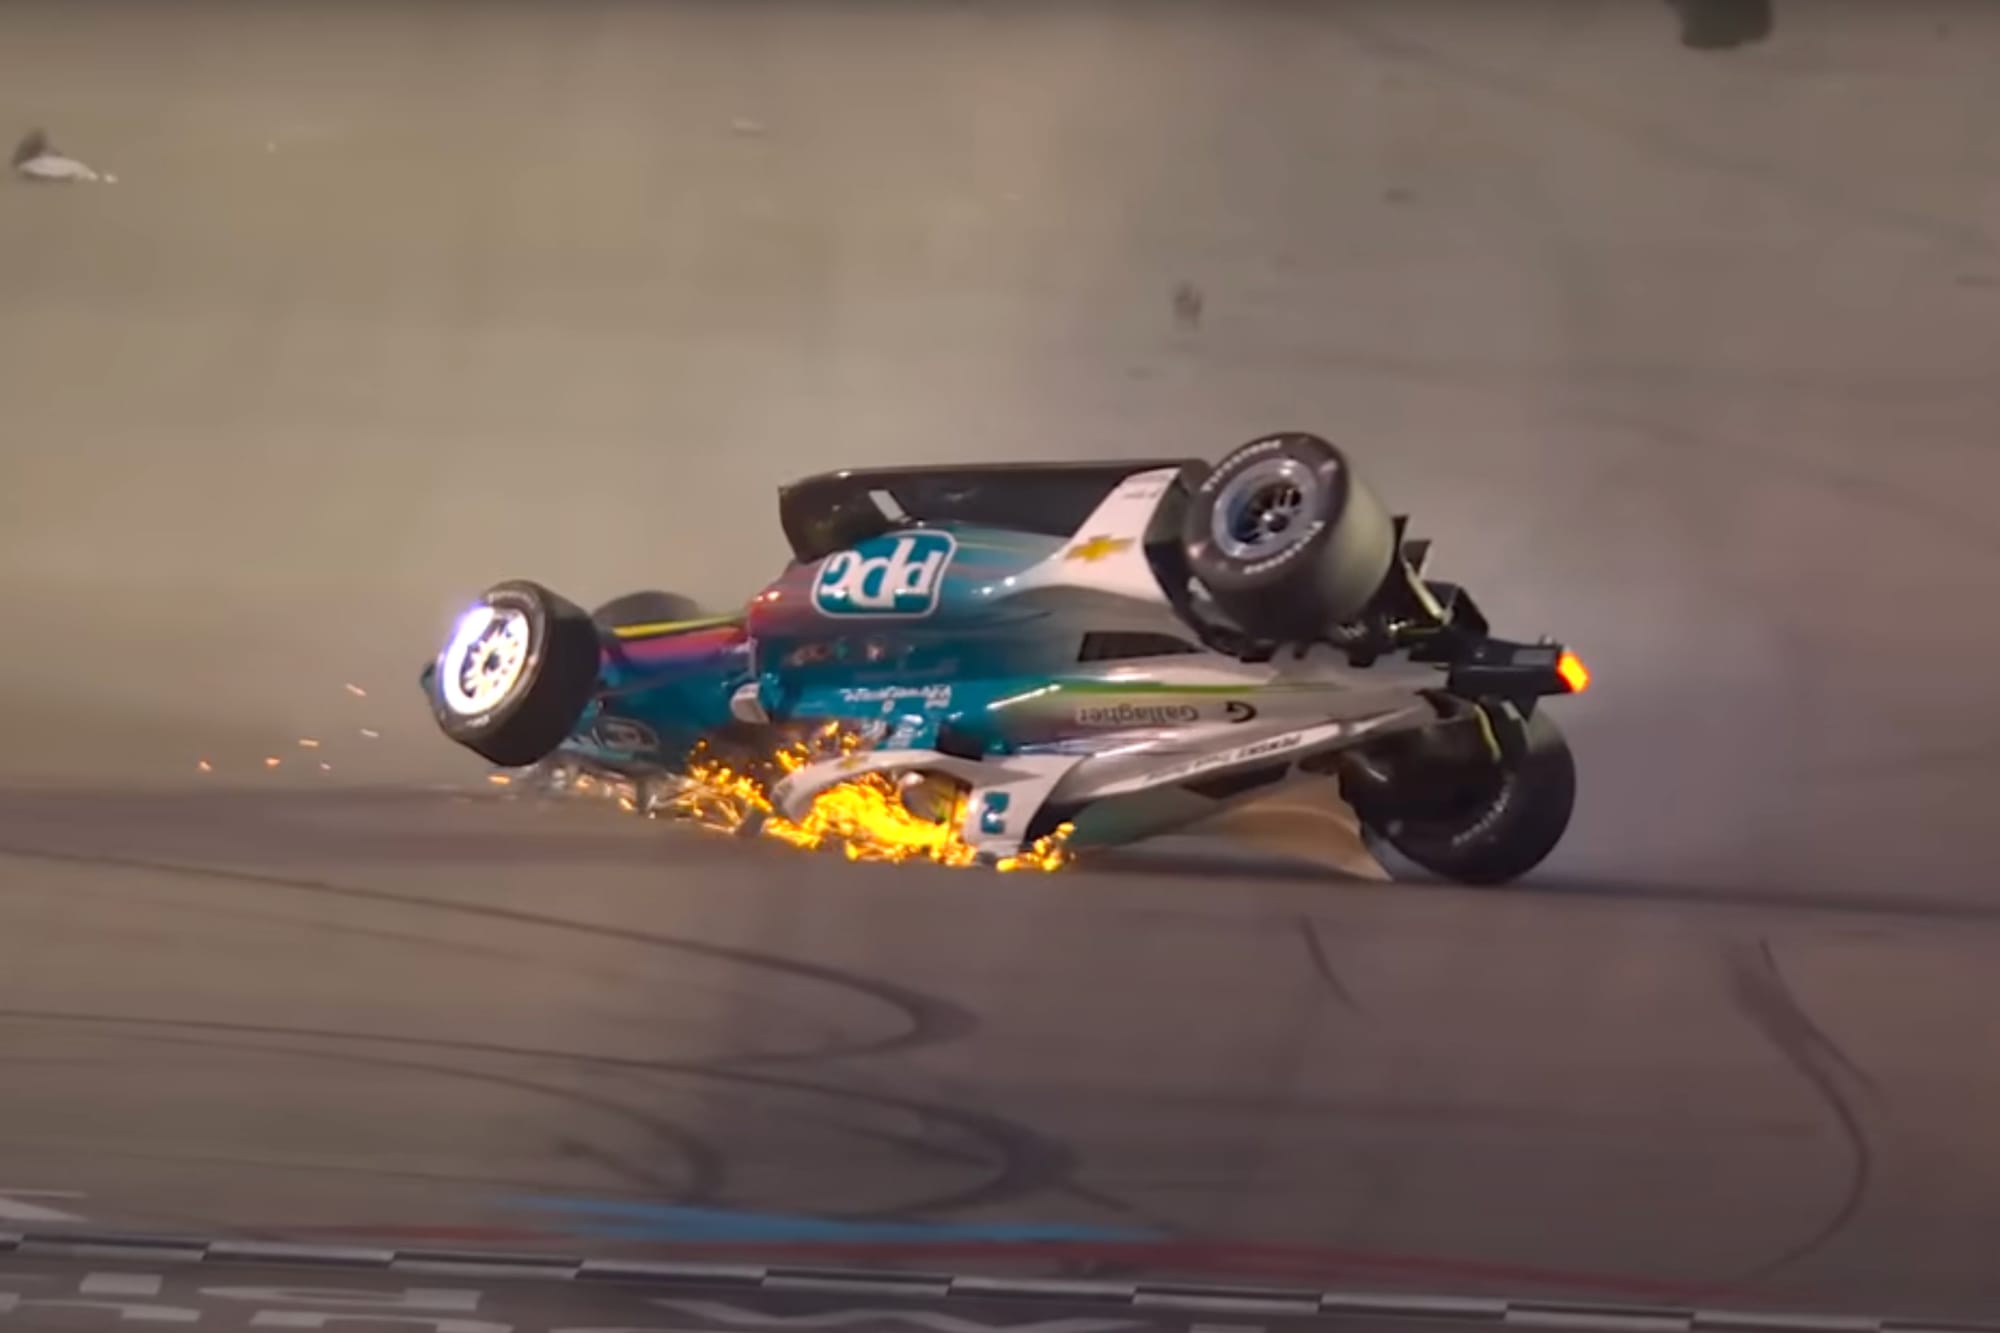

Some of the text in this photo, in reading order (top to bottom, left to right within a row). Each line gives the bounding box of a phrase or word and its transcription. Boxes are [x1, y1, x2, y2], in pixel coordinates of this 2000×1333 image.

[818, 538, 944, 610] PPG
[1079, 703, 1200, 725] Gallagher
[980, 791, 1011, 835] 2
